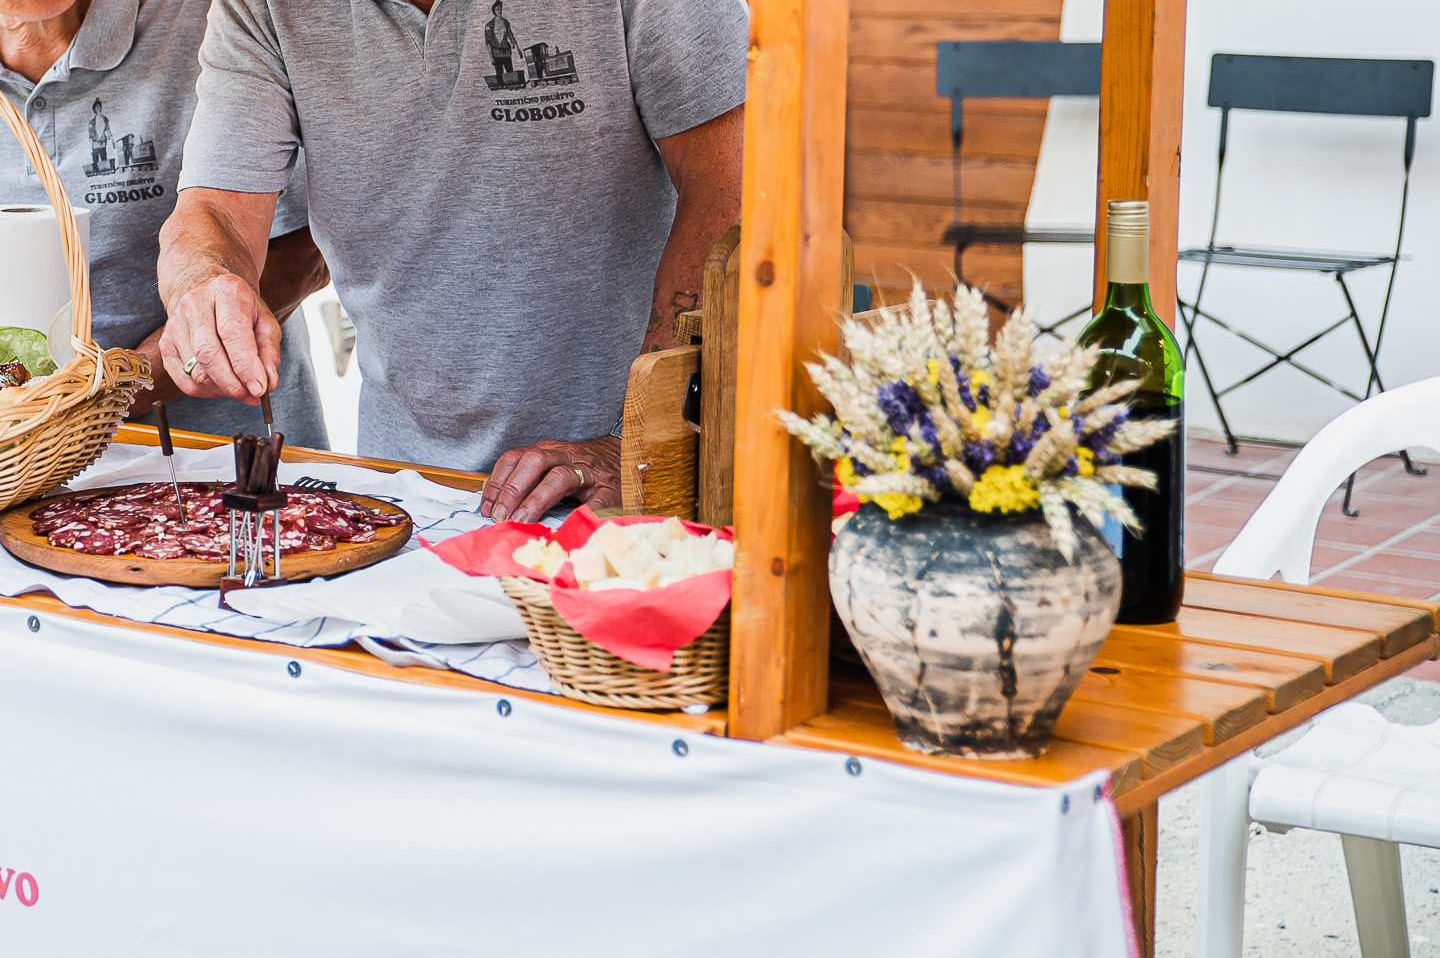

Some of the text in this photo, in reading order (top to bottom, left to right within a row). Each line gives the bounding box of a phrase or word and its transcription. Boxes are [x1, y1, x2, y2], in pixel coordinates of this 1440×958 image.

[495, 91, 575, 106] TURISTIČNO DRUŠTVO
[490, 99, 586, 123] GLOBOKO
[84, 184, 165, 205] GLOBOKO
